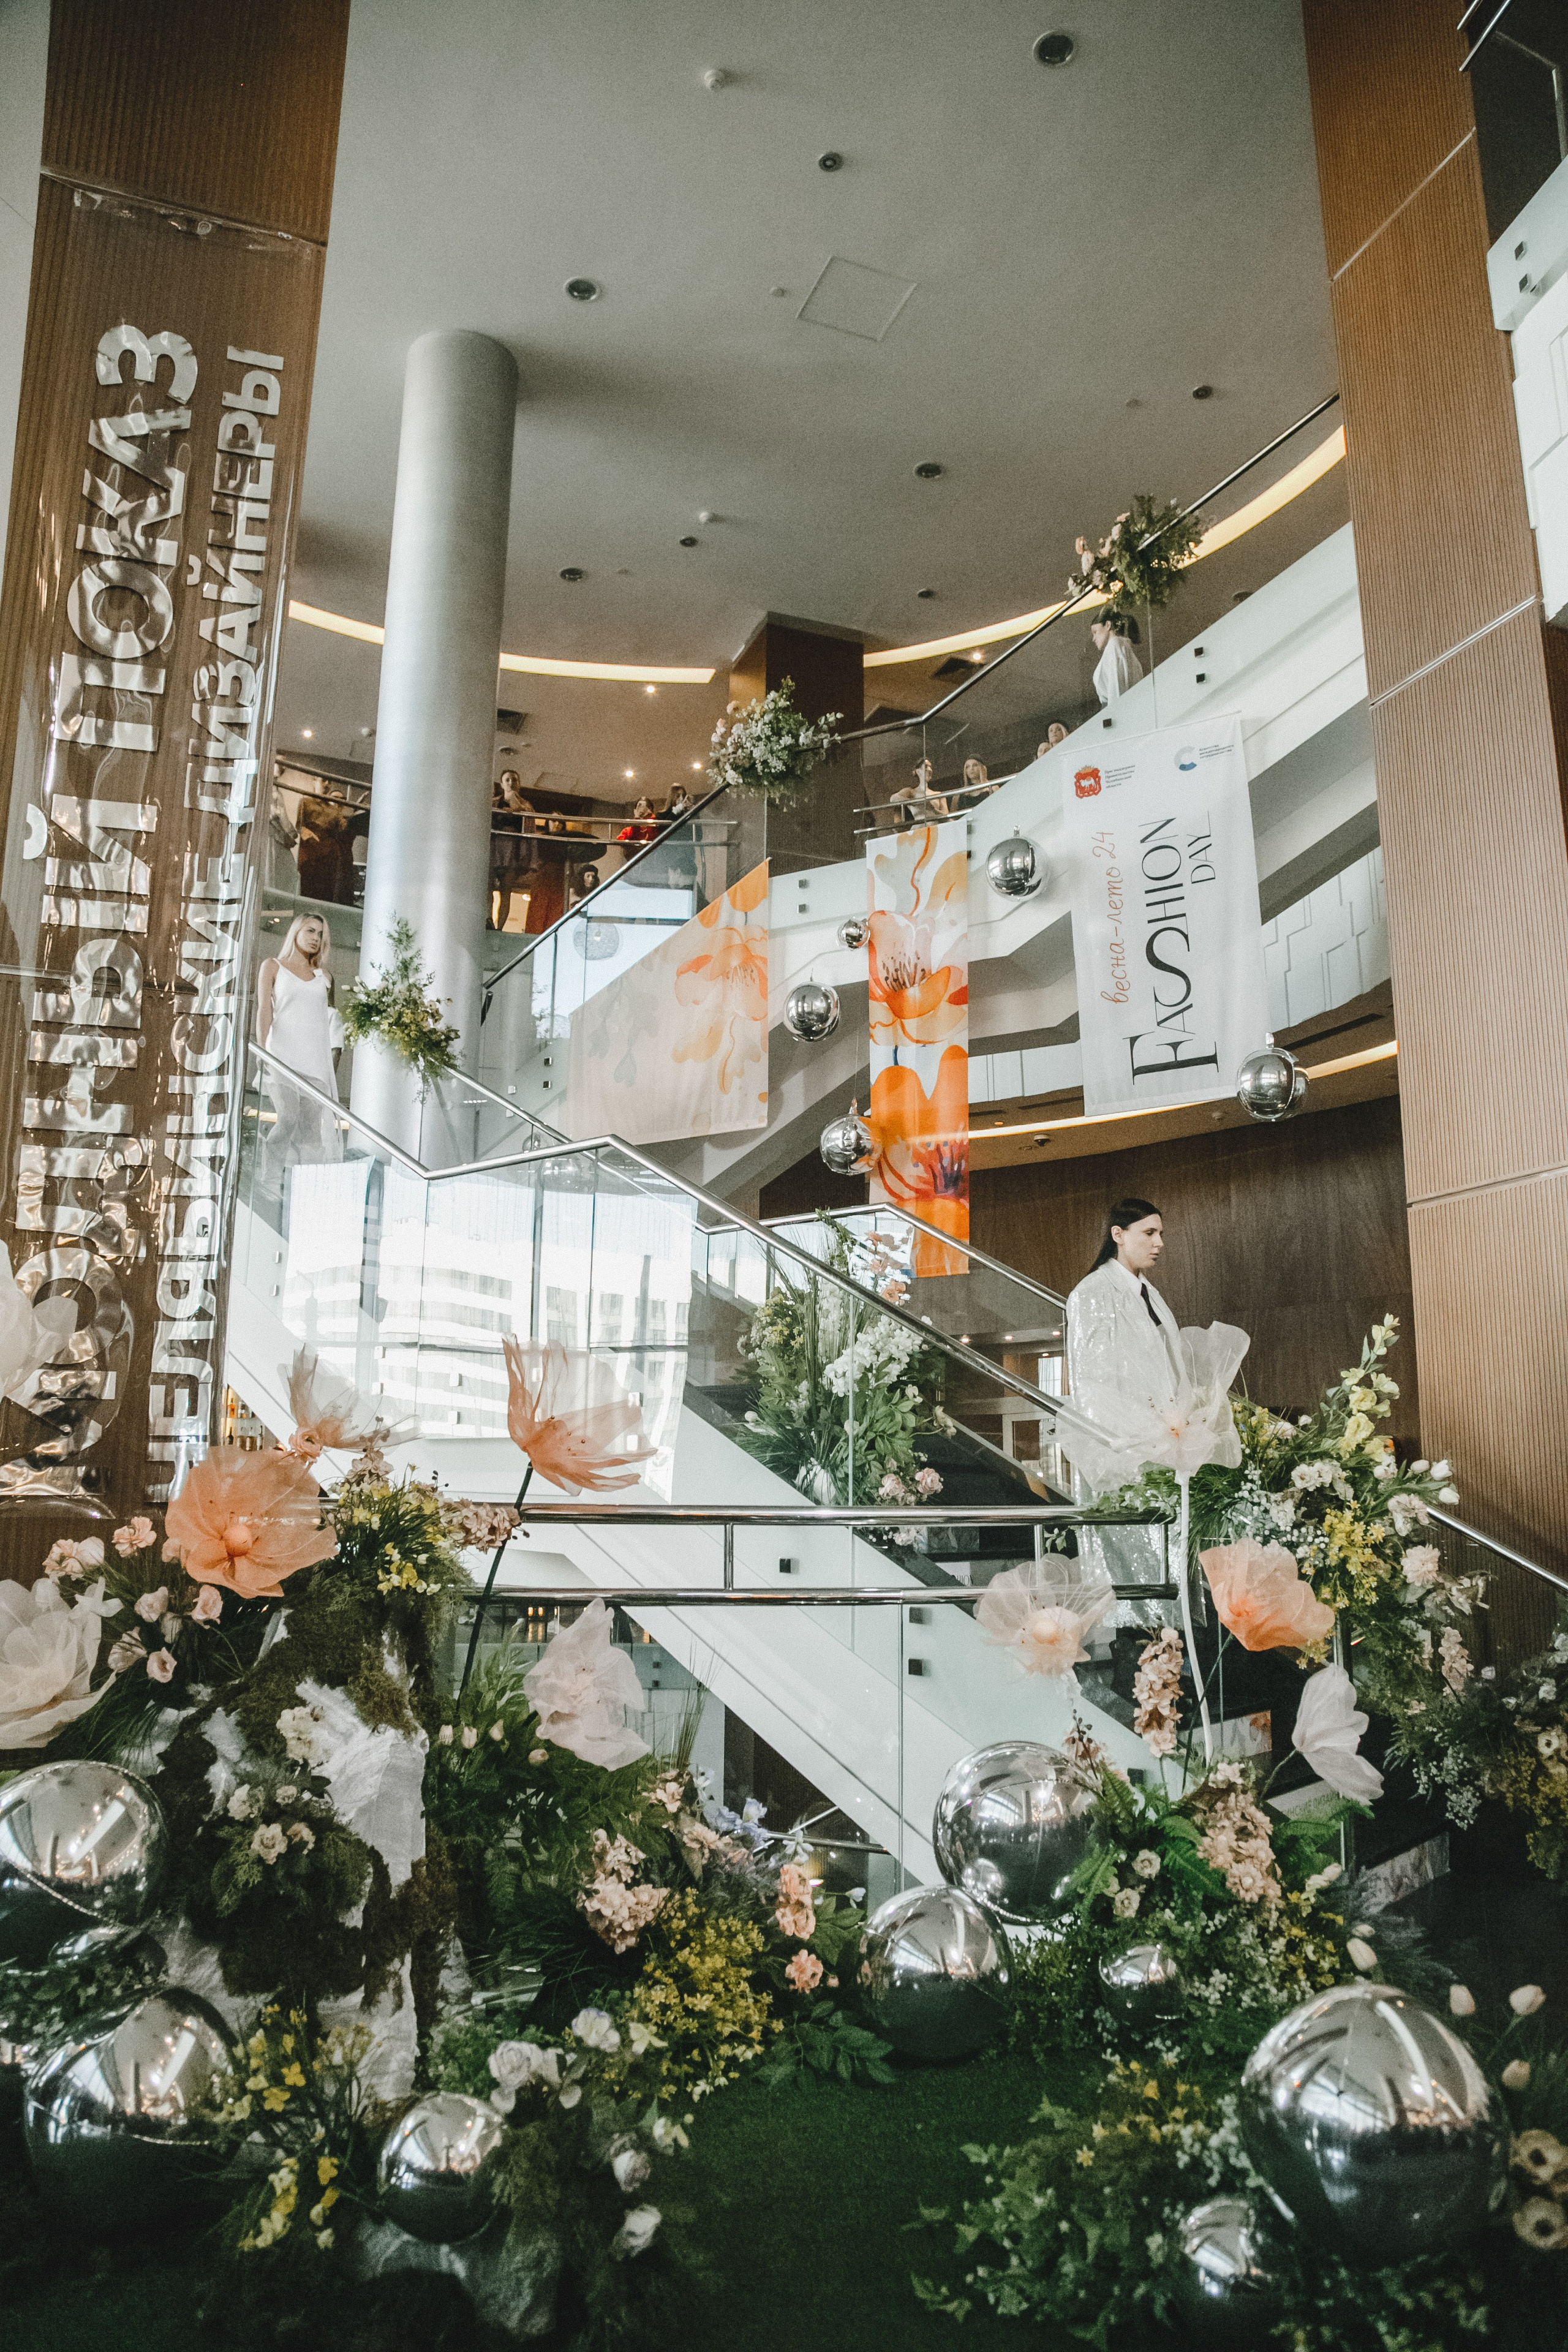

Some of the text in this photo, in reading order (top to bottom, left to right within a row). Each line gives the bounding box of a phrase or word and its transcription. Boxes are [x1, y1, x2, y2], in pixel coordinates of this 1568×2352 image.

[54, 325, 198, 752] ПОКАЗ
[147, 345, 284, 1502] ЧЕЛЯБИНСКИЕ ДИЗАЙНЕРЫ
[1091, 831, 1130, 1003] весна-лето 24
[1123, 818, 1219, 1085] FASHION
[1186, 811, 1216, 884] DAY
